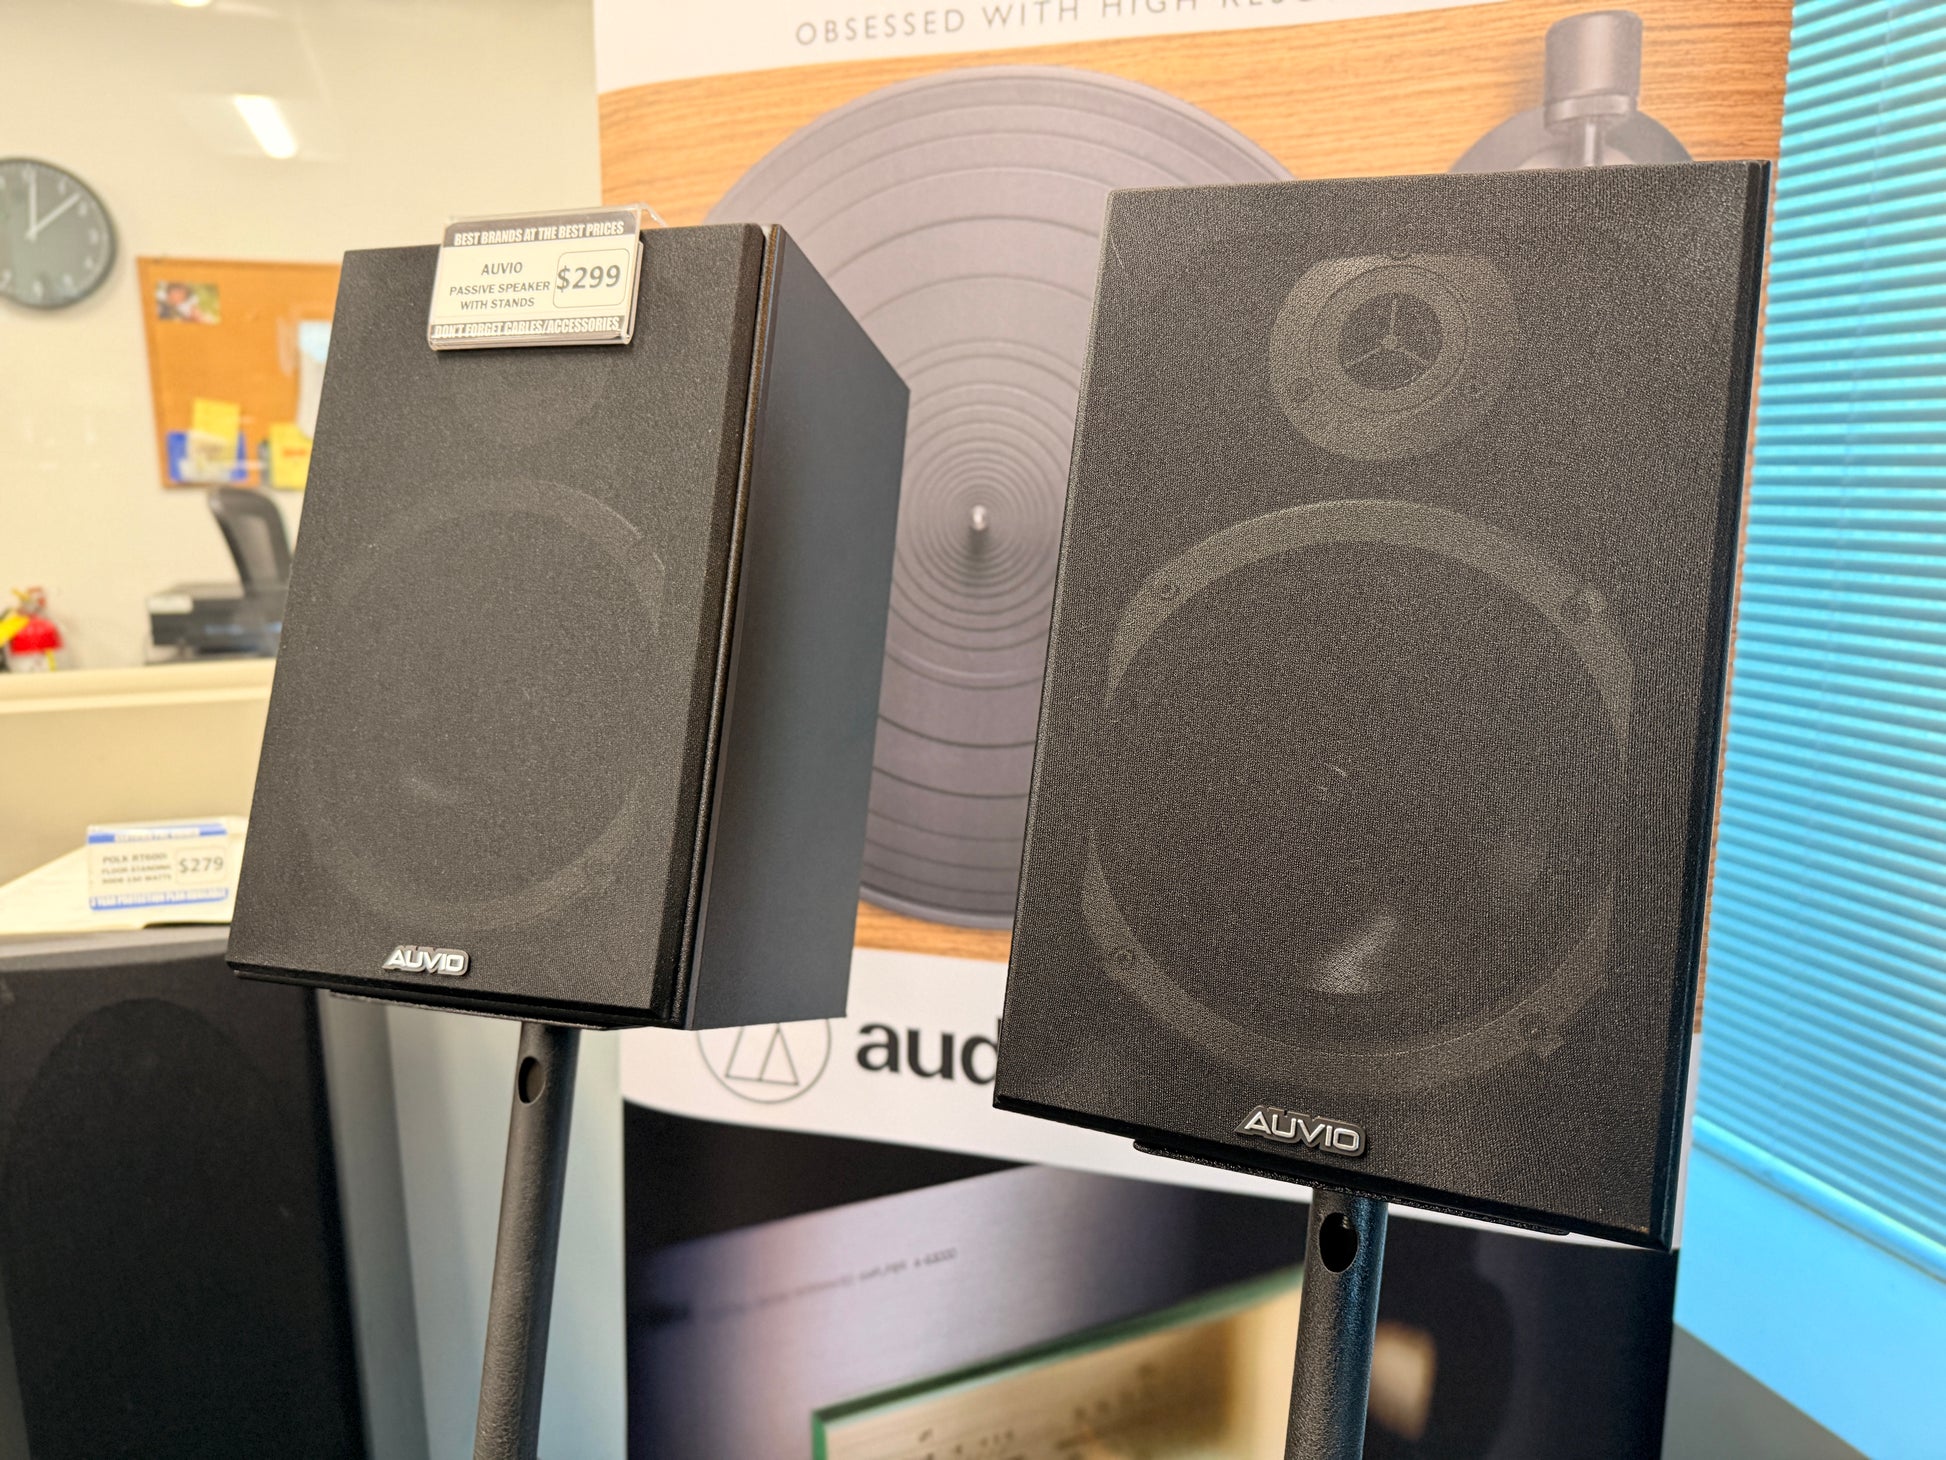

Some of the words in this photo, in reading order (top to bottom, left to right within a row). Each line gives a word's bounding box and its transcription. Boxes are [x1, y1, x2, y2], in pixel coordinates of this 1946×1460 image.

[795, 9, 965, 46] OBSESSED
[982, 0, 1079, 28] WITH
[454, 232, 480, 246] BEST
[480, 229, 523, 245] BRANDS
[523, 228, 538, 242] AT
[538, 226, 557, 241] THE
[558, 224, 586, 239] BEST
[586, 221, 625, 236] PRICES
[481, 262, 523, 276] AUVIO
[556, 264, 621, 293] $299
[449, 284, 495, 297] PASSIVE
[497, 281, 551, 294] SPEAKER
[460, 299, 490, 311] WITH
[491, 297, 535, 309] STANDS
[465, 322, 503, 337] FORGET
[179, 856, 224, 874] $279
[386, 948, 466, 973] AUVIO
[1243, 1110, 1360, 1152] AUVIO
